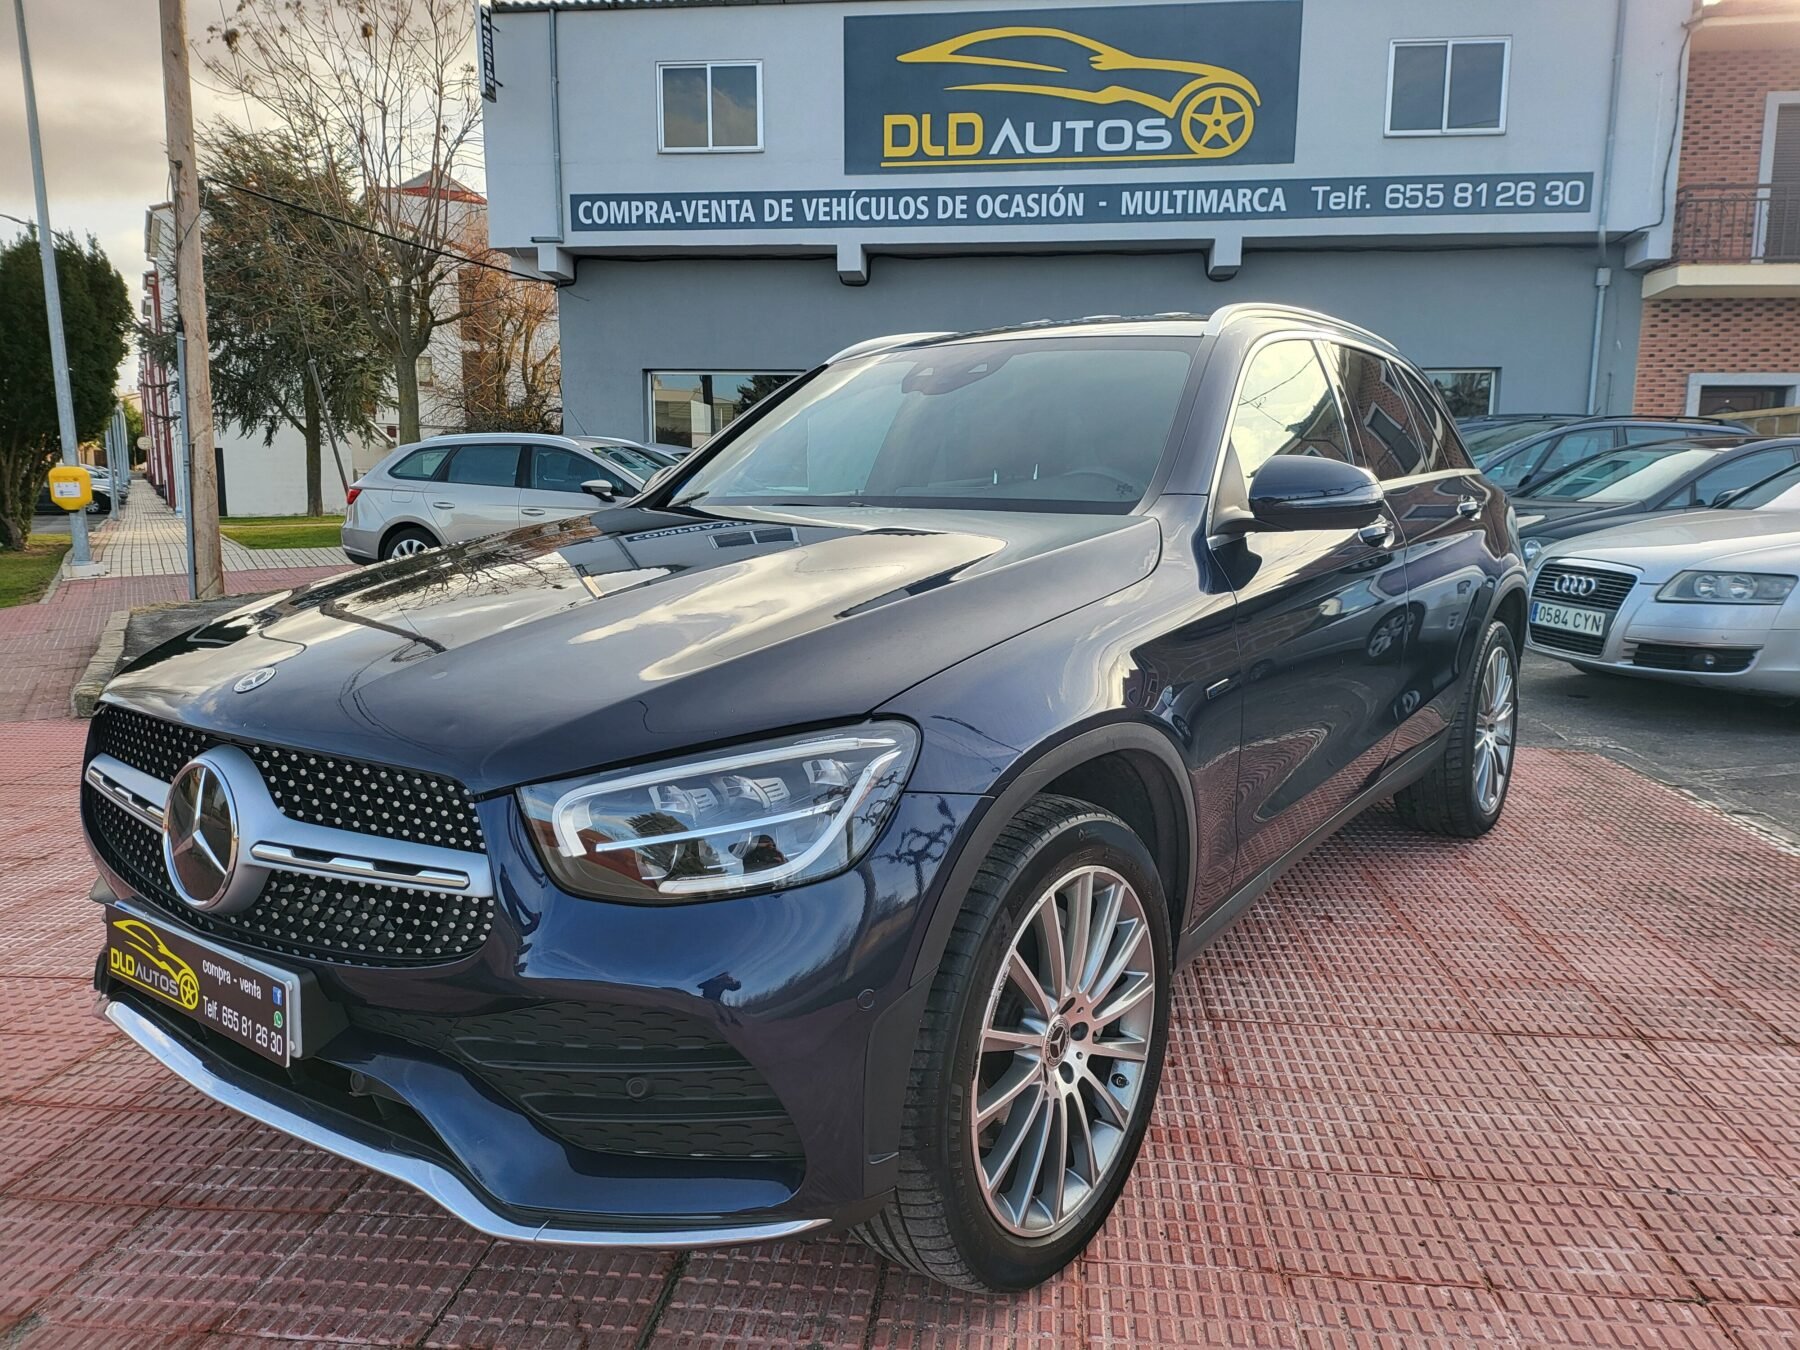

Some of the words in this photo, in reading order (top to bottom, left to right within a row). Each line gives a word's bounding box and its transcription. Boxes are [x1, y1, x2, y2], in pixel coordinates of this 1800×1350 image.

[883, 112, 984, 158] DLD
[988, 117, 1173, 155] AUTOS
[578, 198, 756, 225] COMPRA-VENTA
[764, 198, 794, 223] DE
[801, 191, 930, 222] VEHÍCULOS
[937, 195, 968, 220] DE
[976, 186, 1085, 219] OCASIÓN
[1121, 187, 1287, 216] MULTIMARCA
[1311, 184, 1371, 211] Telf.
[1384, 183, 1444, 209] 655
[1453, 182, 1488, 208] 81
[1495, 181, 1536, 207] 26
[1543, 180, 1586, 206] 30
[1538, 606, 1569, 627] 0584
[1572, 612, 1602, 633] CYN
[110, 947, 135, 977] DLD
[135, 960, 179, 996] AUTOS
[202, 959, 232, 985] compra
[239, 976, 262, 1000] venta
[202, 995, 220, 1022] Telf.
[221, 1006, 239, 1033] 655
[241, 1016, 253, 1040] 81
[255, 1023, 268, 1048] 26
[270, 1032, 283, 1056] 30
